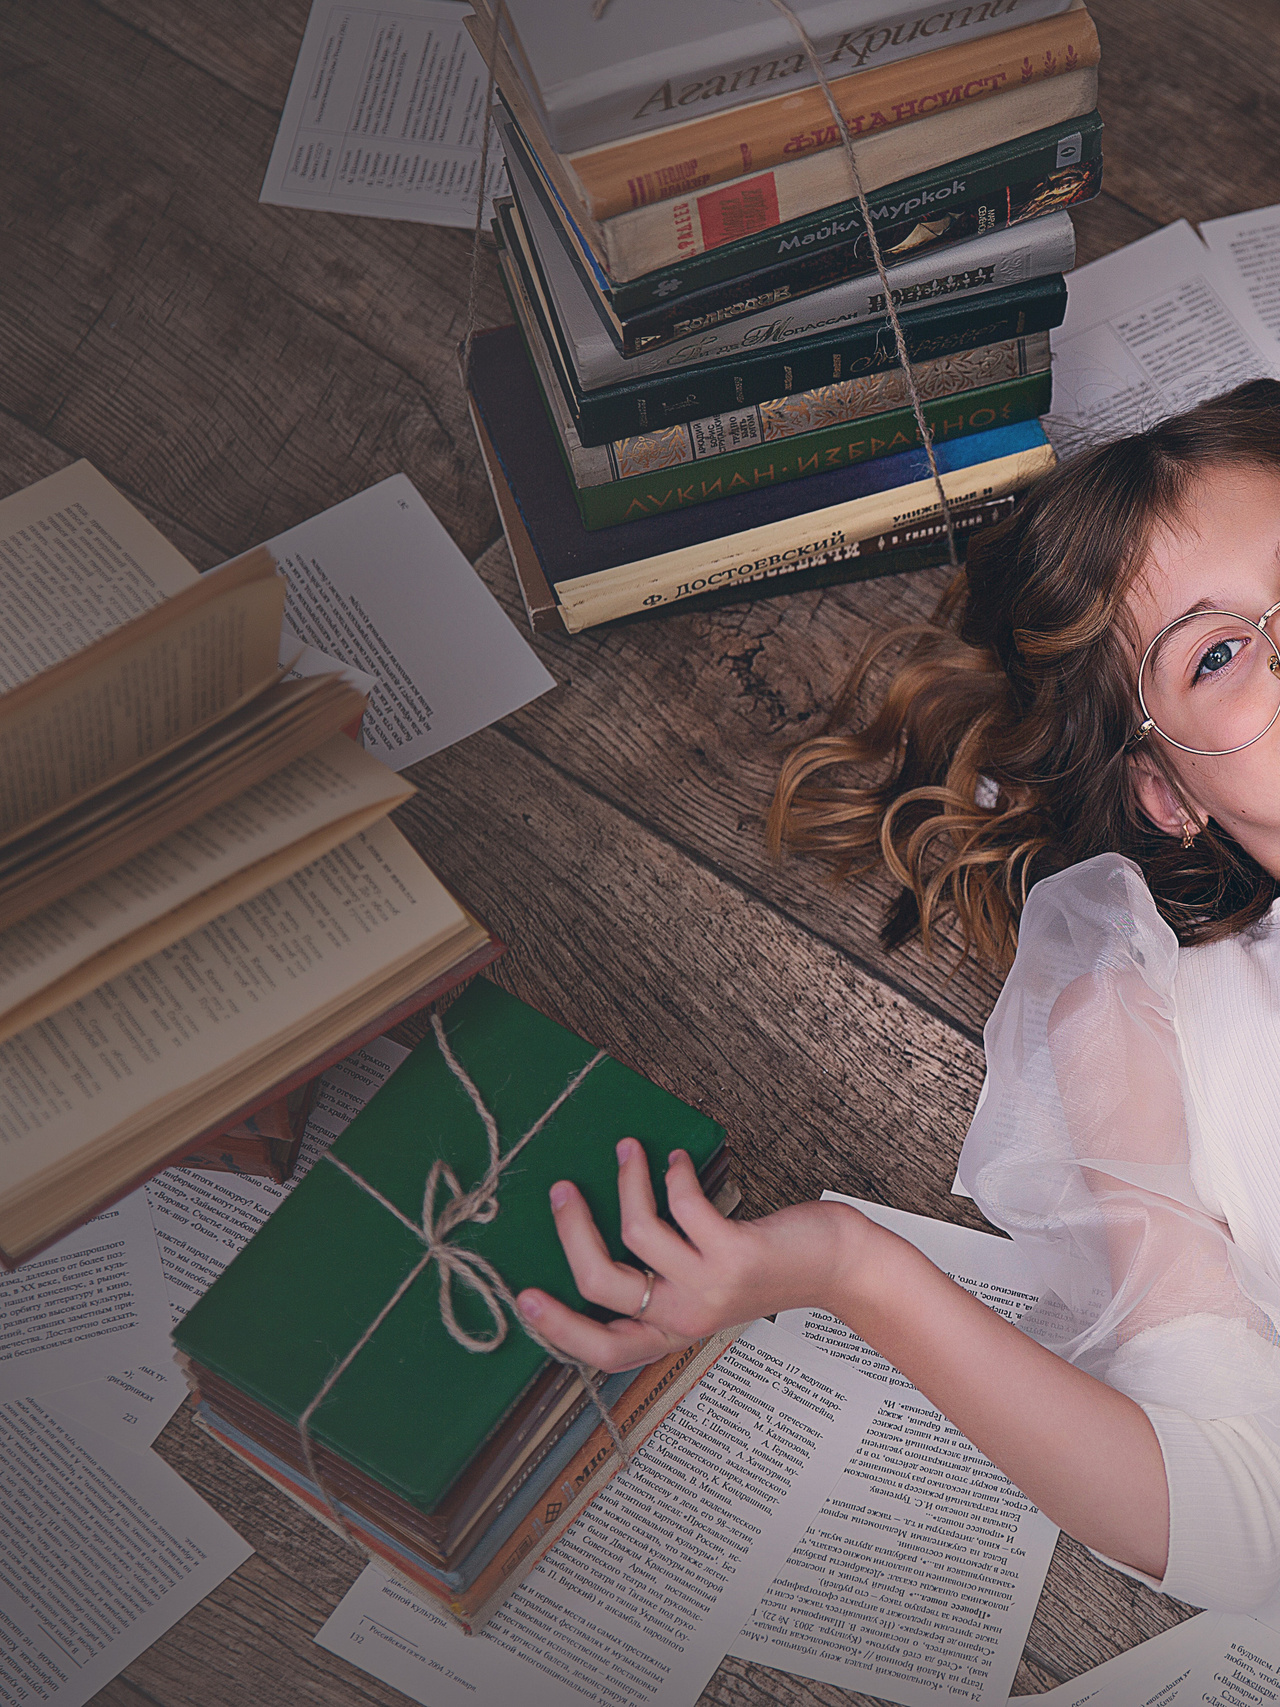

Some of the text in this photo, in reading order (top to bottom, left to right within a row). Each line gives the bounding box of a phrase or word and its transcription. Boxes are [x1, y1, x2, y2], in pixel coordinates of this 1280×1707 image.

[634, 53, 802, 120] Агата
[784, 72, 1006, 154] ФИНАНСИСТ
[673, 202, 696, 250] ФАДЕЕВ
[777, 180, 966, 254] Майкл Муркок
[621, 464, 775, 518] ЛУКИАН
[674, 529, 847, 598] ДОСТОЕВСКИЙ
[156, 1203, 235, 1249] ток-шоу «Окна», «За
[728, 1343, 764, 1369] фильмов
[763, 1365, 783, 1379] всех
[782, 1375, 811, 1395] времен
[818, 1395, 842, 1411] наро-
[755, 1348, 848, 1401] опроса 117 ведущих ис-
[121, 1411, 138, 1424] 223
[637, 1446, 687, 1482] Свешникова,
[697, 1480, 732, 1506] Минина.
[868, 1484, 911, 1505] Тургеневу.
[913, 1497, 933, 1510] И.С.
[934, 1503, 969, 1518] повезло
[981, 1516, 1018, 1533] Сначала
[349, 1631, 365, 1645] 132
[1212, 1671, 1263, 1706] («Варвары»).
